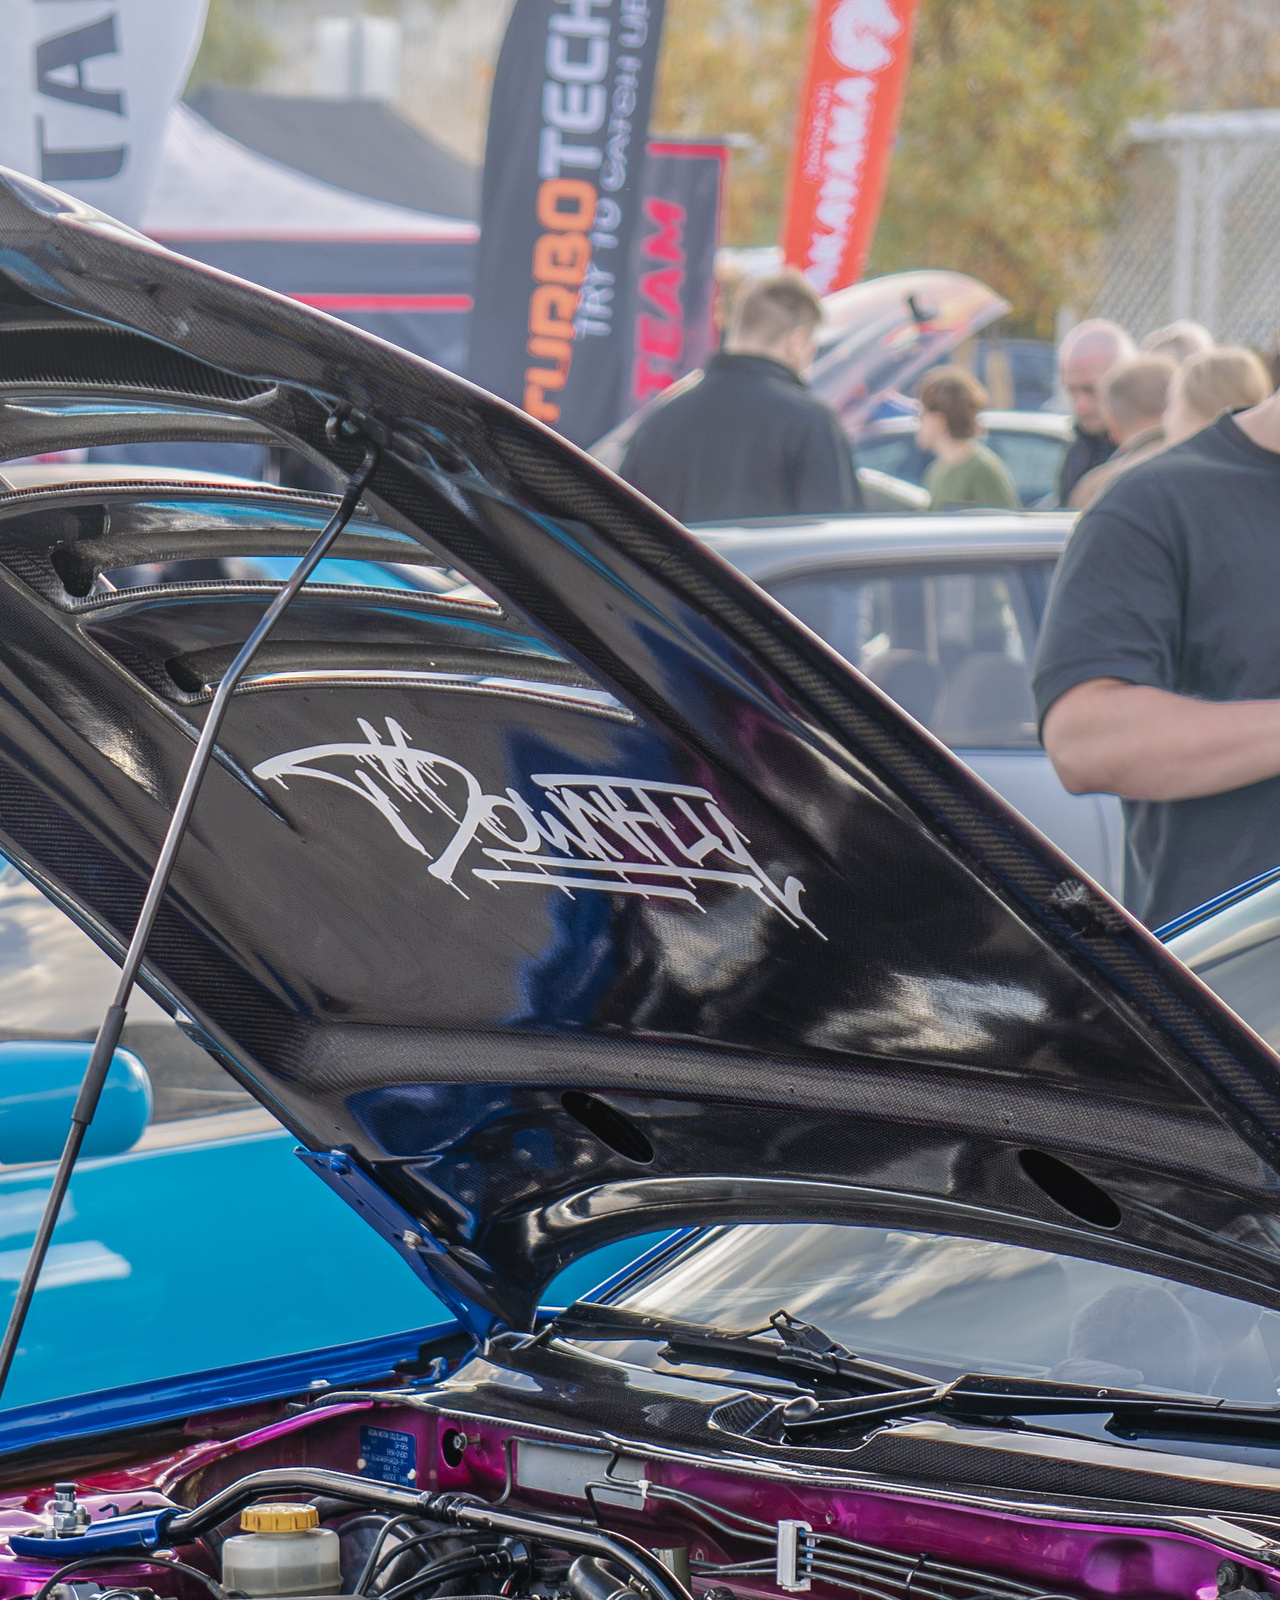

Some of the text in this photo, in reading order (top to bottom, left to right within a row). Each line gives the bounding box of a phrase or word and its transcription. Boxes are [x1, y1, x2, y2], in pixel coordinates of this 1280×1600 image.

[588, 196, 623, 249] TO
[574, 260, 616, 342] TRY
[635, 197, 687, 404] TEAM
